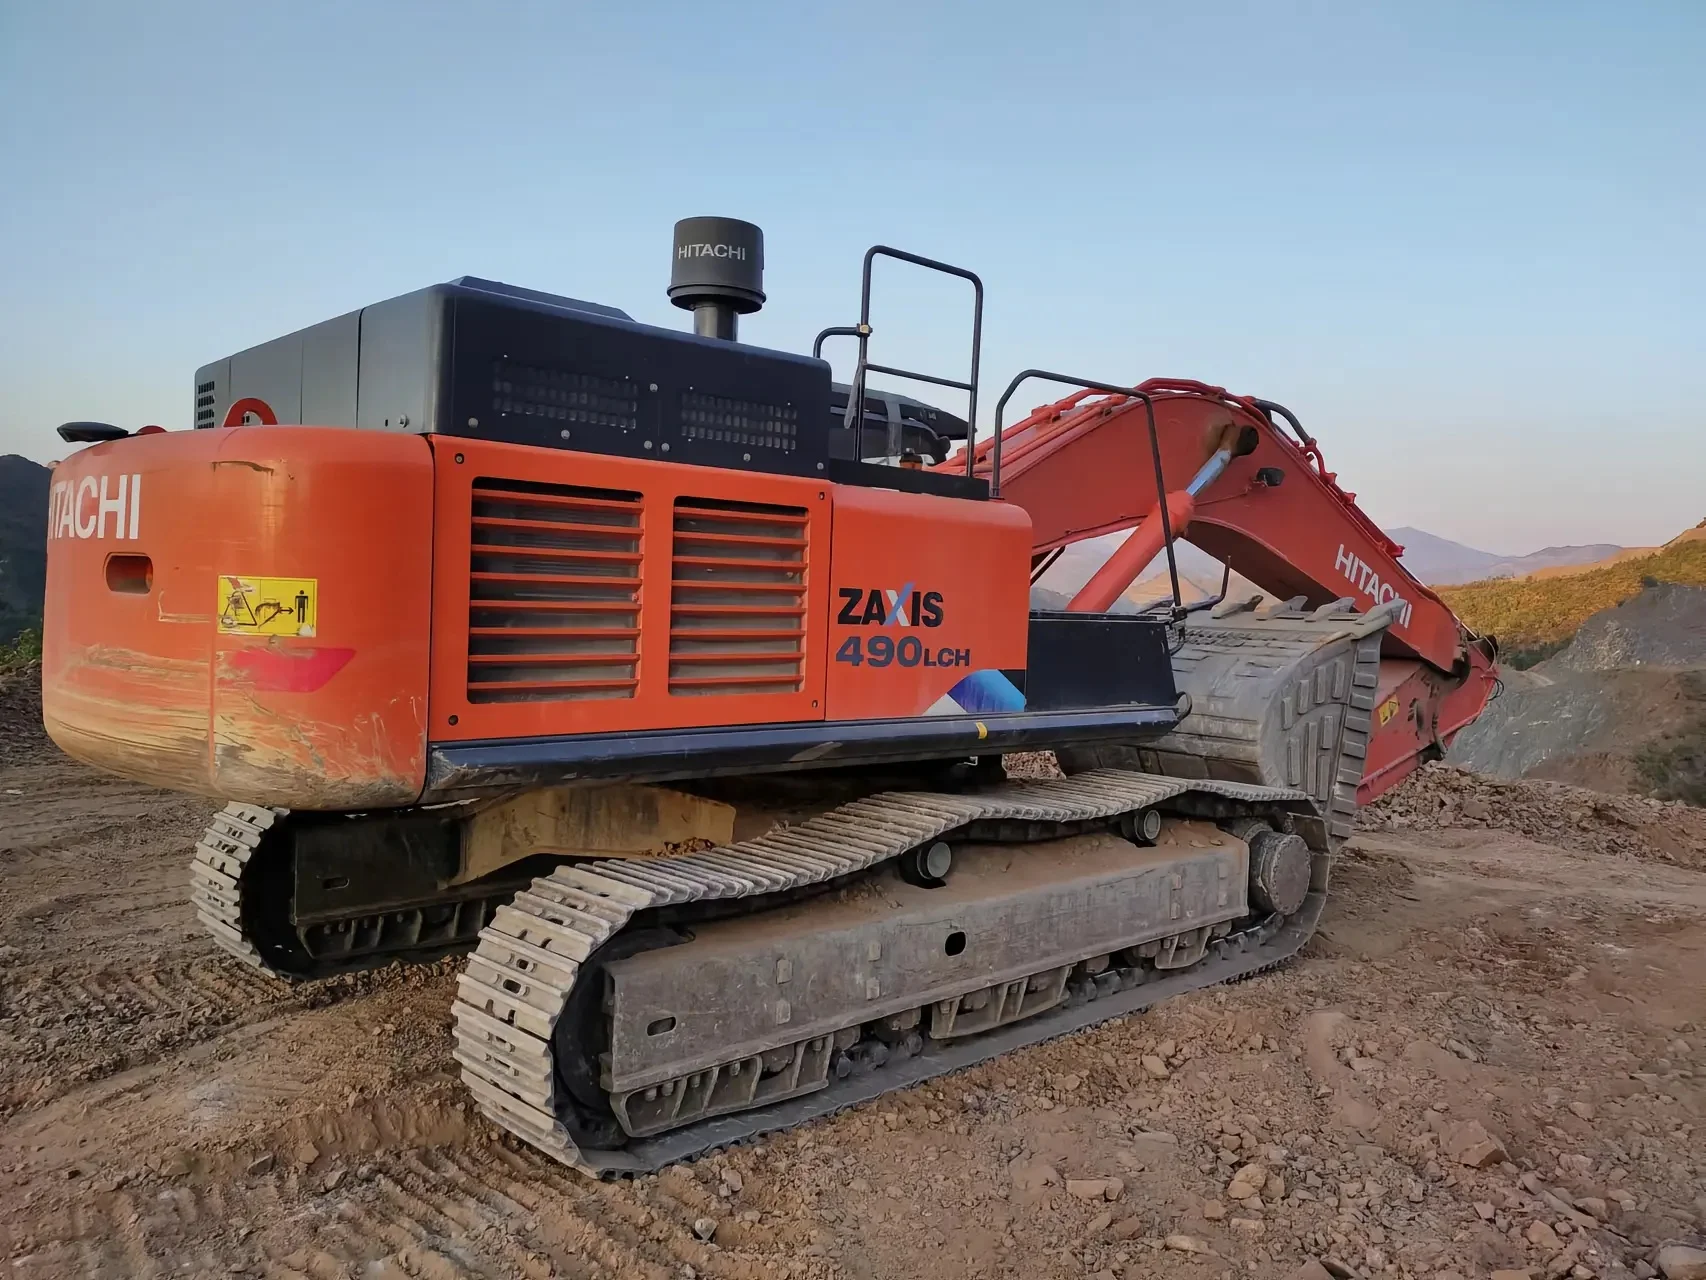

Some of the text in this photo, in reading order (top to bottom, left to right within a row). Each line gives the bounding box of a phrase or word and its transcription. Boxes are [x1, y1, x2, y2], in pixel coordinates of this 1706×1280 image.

[677, 243, 746, 261] HITACHI
[48, 474, 141, 540] ITACHI
[837, 581, 944, 628] ZAXIS
